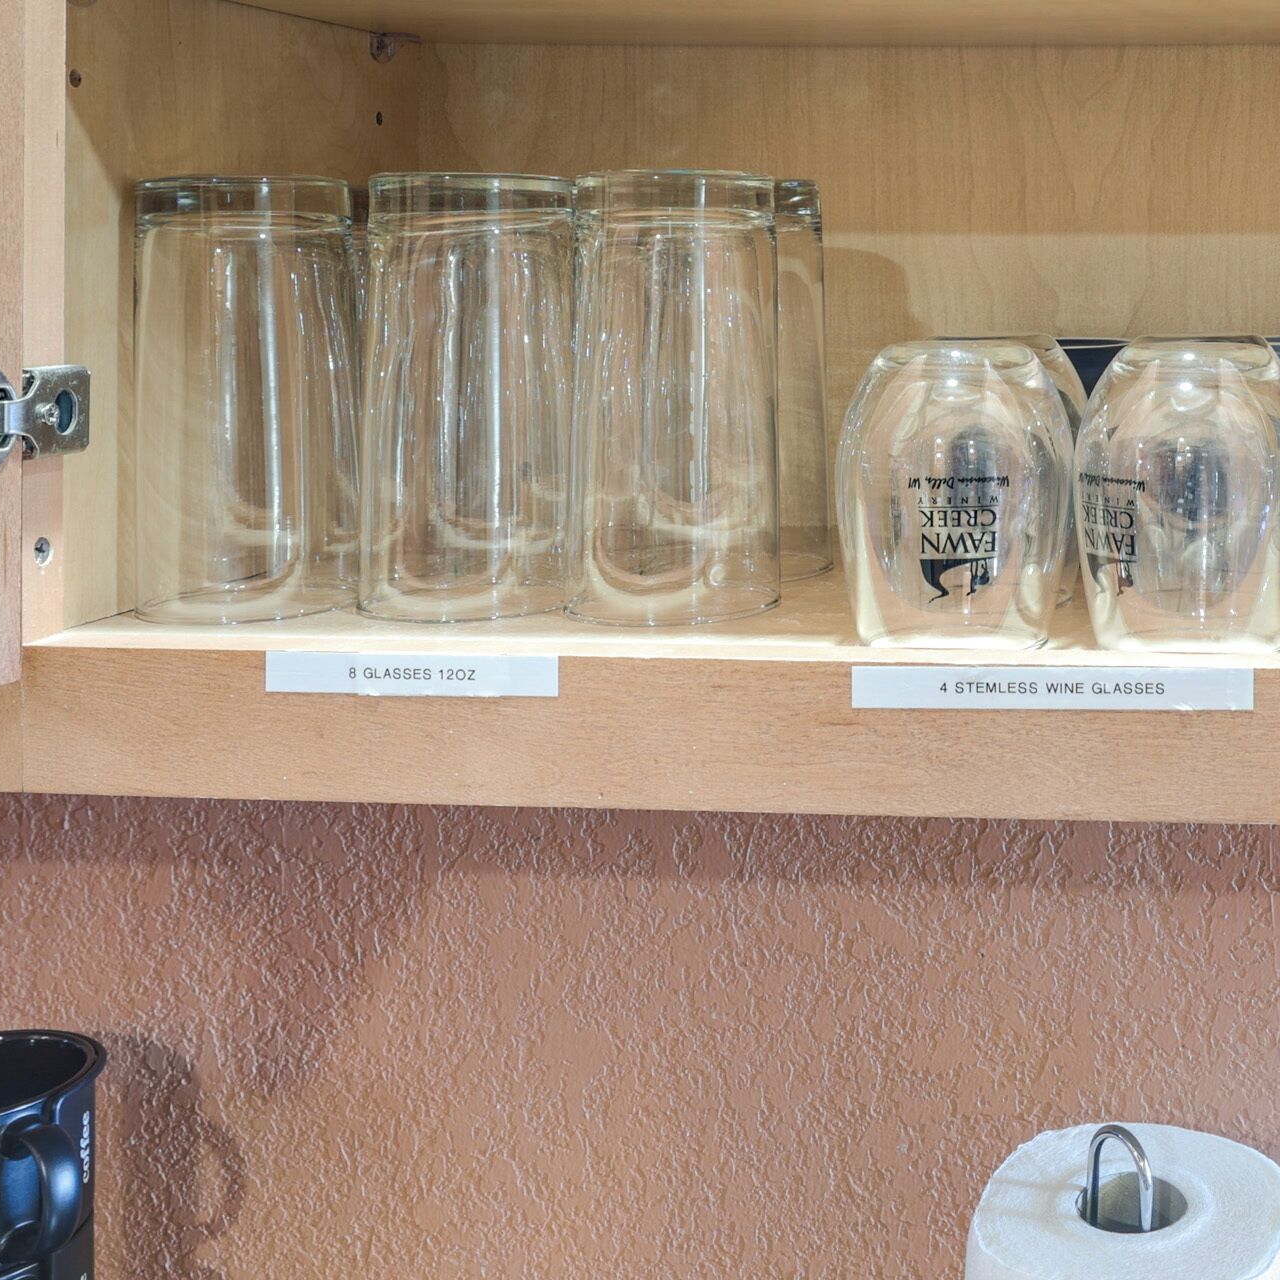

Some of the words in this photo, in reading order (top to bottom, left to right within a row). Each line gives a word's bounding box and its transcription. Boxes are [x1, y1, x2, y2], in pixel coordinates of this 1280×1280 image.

[918, 496, 999, 505] WINERY
[919, 508, 997, 528] CREEK
[921, 531, 997, 554] FAWN
[1084, 527, 1137, 556] FAWN
[349, 667, 357, 679] 8
[363, 667, 432, 680] GLASSES
[940, 682, 948, 693] 4
[955, 682, 1038, 694] STEMLESS
[1046, 683, 1084, 695] WINE
[1091, 683, 1166, 695] GLASSES
[80, 1110, 90, 1184] coffee
